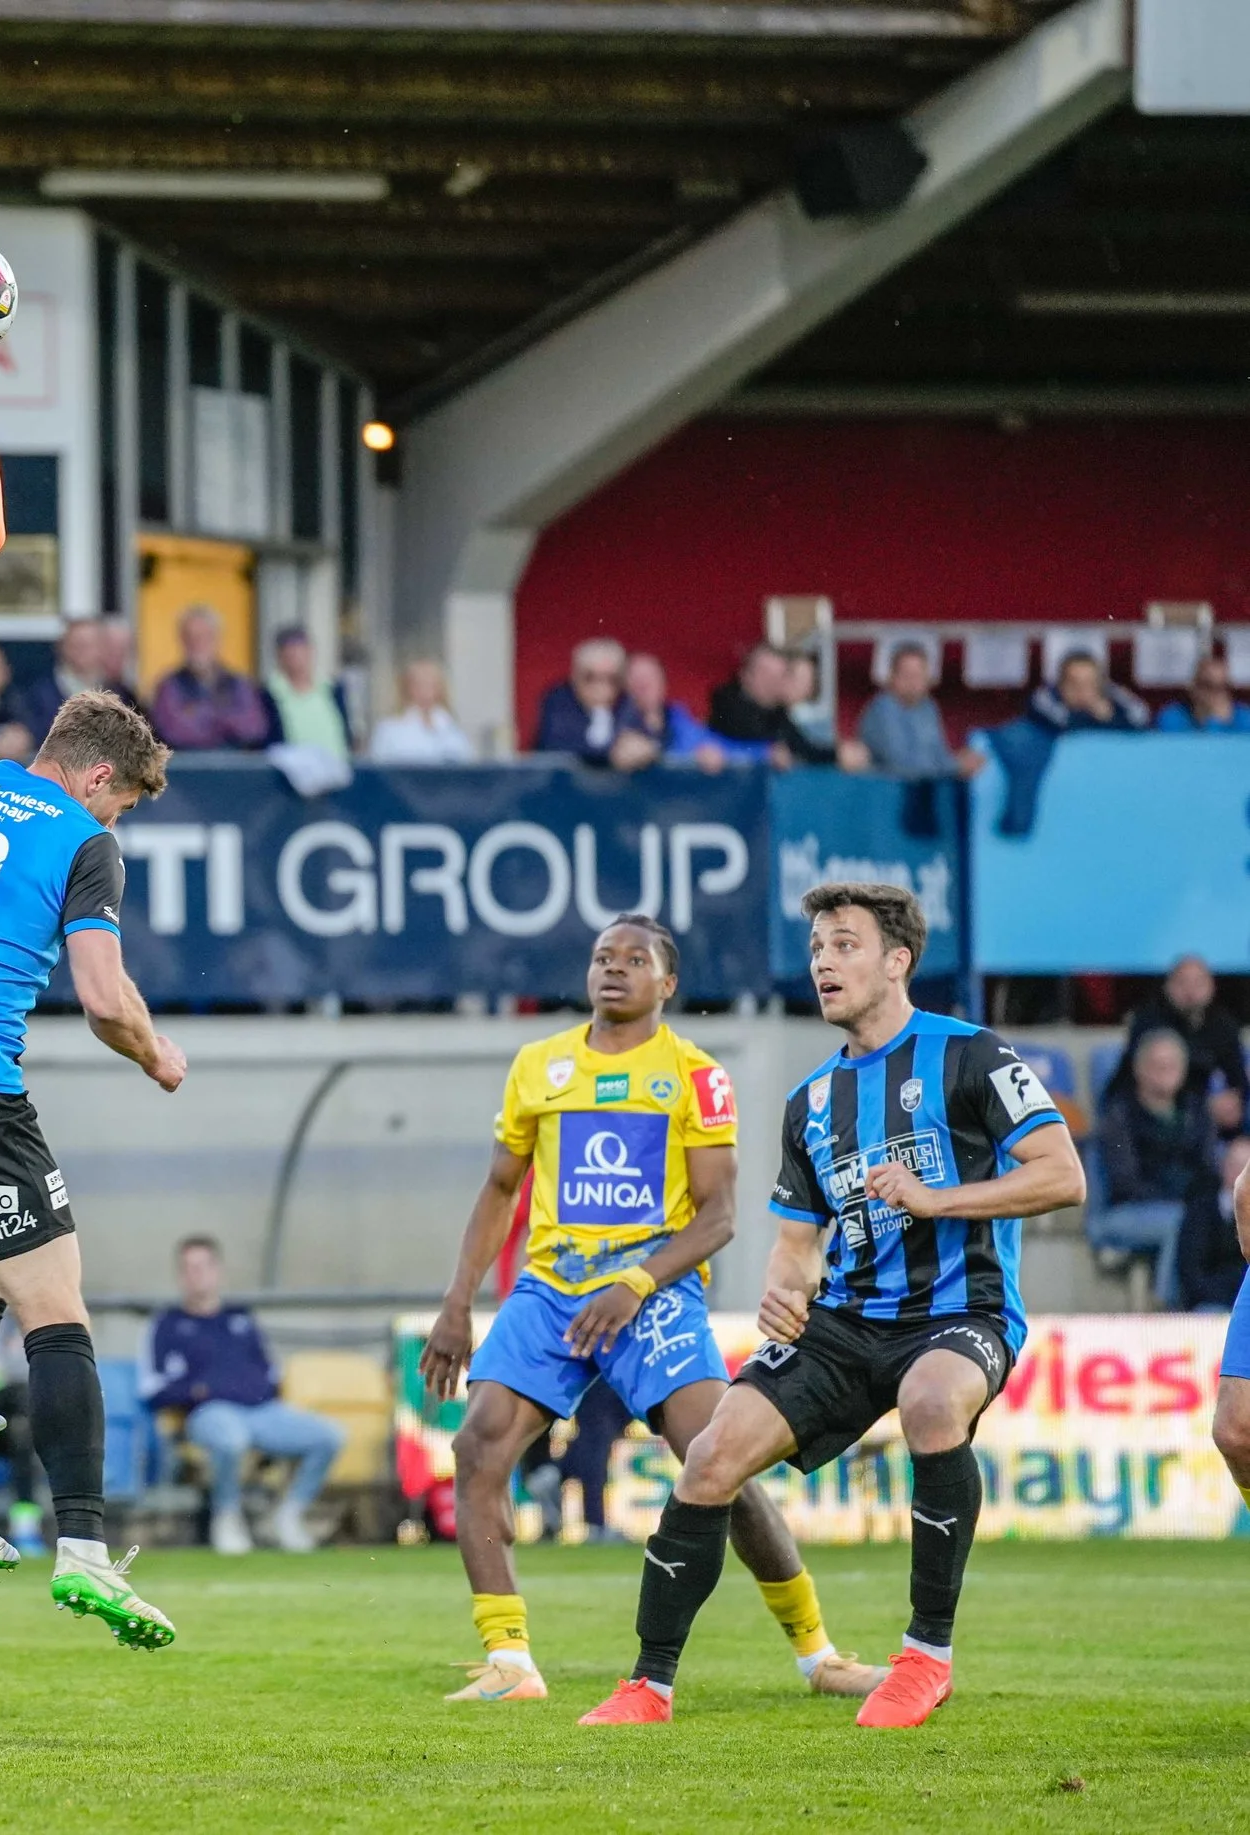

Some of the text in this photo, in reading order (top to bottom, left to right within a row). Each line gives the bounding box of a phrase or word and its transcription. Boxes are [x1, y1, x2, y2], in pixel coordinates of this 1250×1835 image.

[277, 821, 748, 937] GROUP
[563, 1181, 655, 1209] UNIQA
[872, 1215, 913, 1239] group
